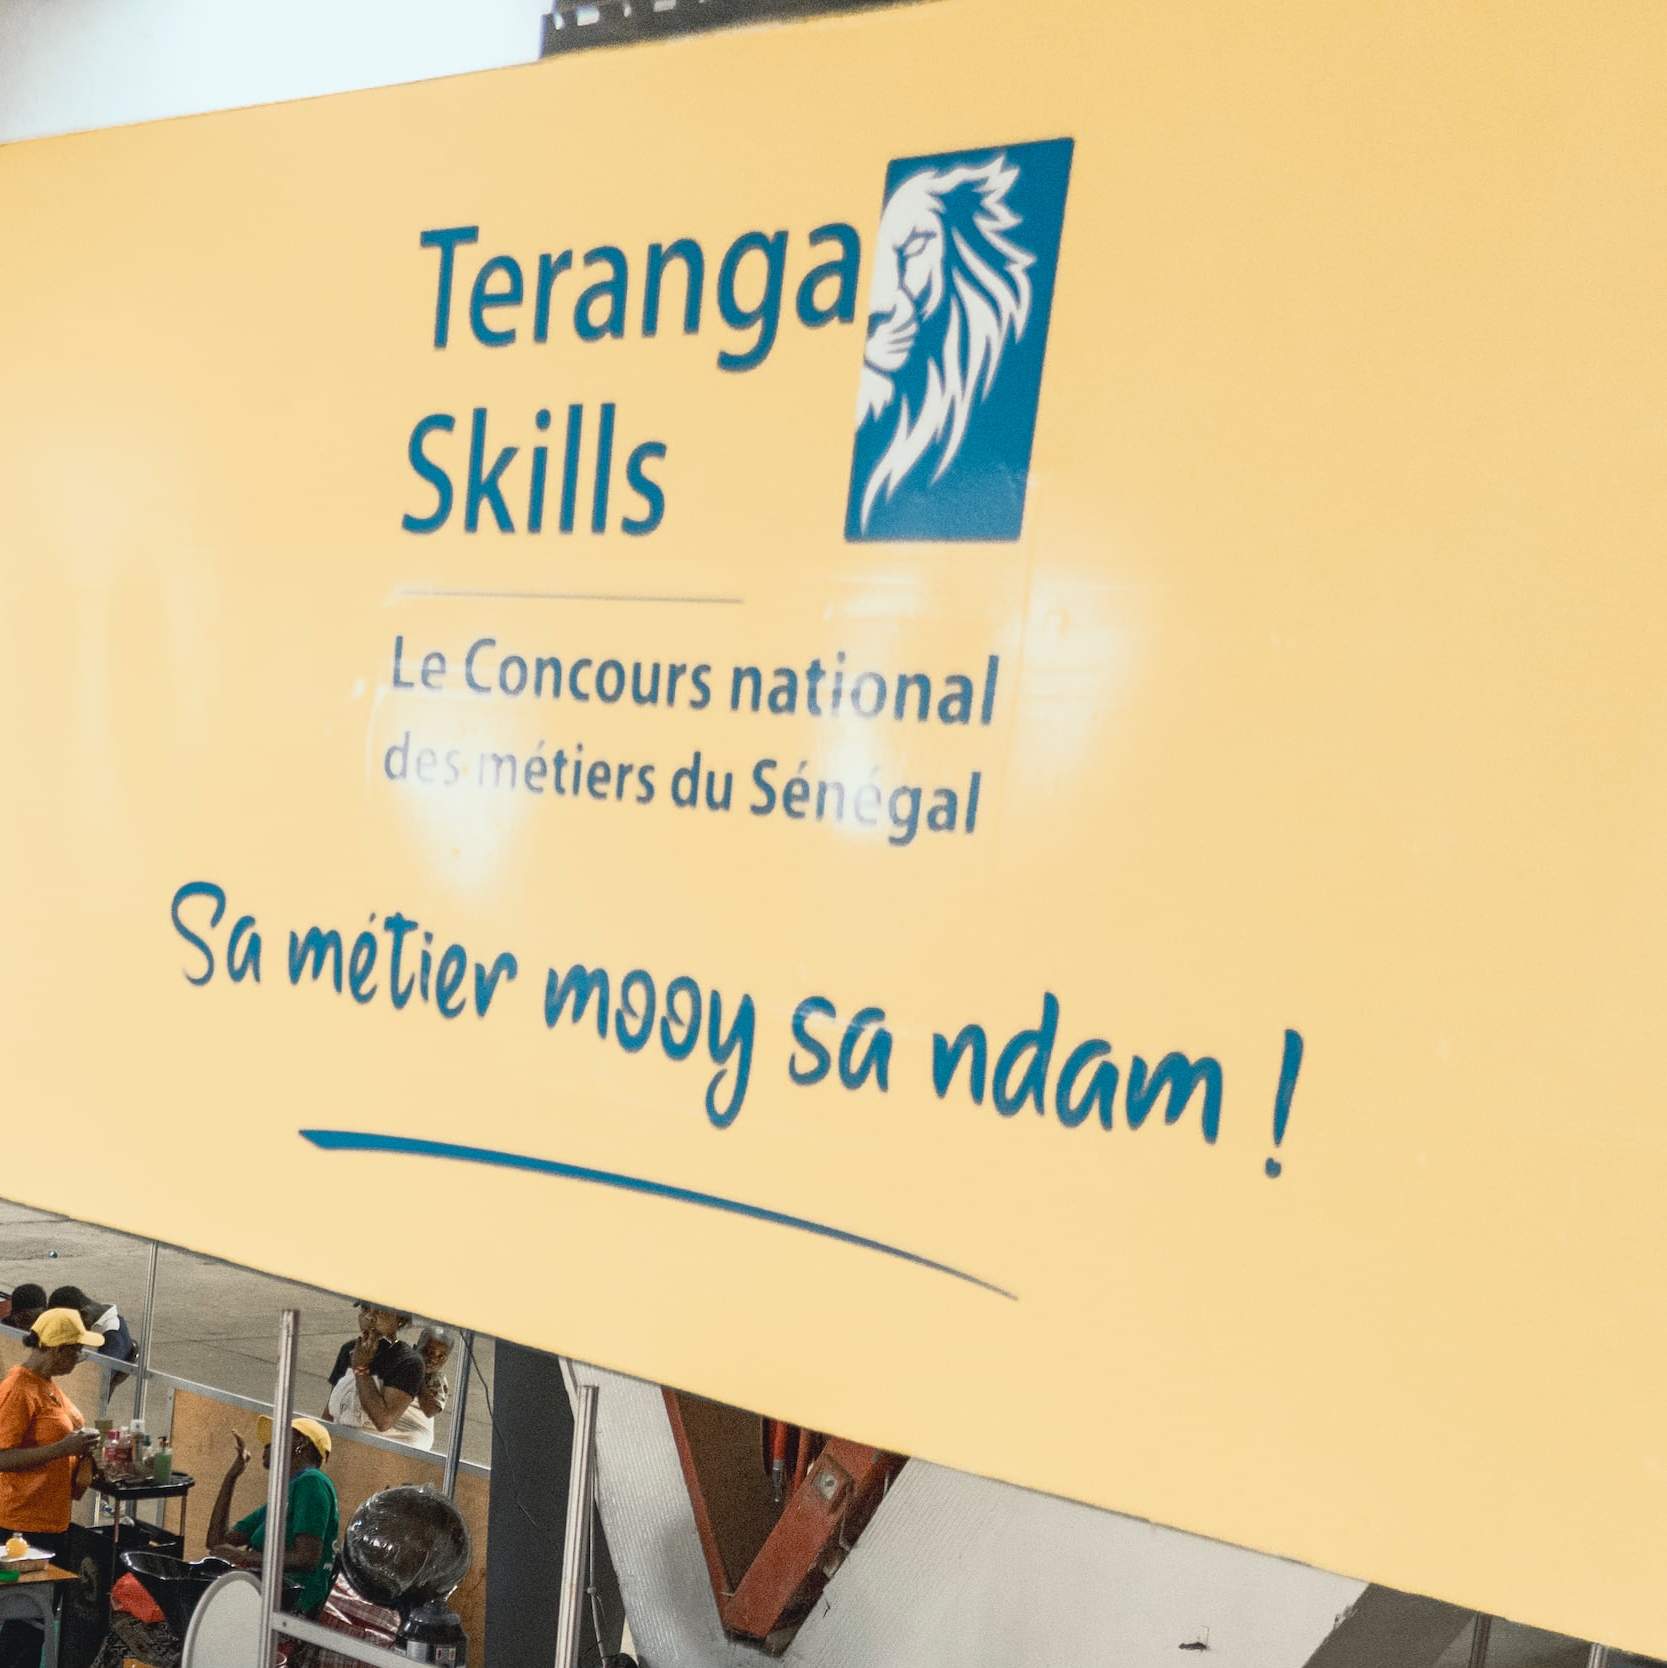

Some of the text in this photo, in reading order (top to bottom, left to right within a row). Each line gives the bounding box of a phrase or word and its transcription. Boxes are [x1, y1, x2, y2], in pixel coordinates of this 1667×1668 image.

[419, 220, 862, 373] Teranga
[401, 402, 668, 536] Skills
[390, 634, 1000, 727] Le Concours national
[383, 731, 982, 848] des métiers du Sénégal
[169, 880, 1305, 1179] Sa métier mooy sa ndam !
